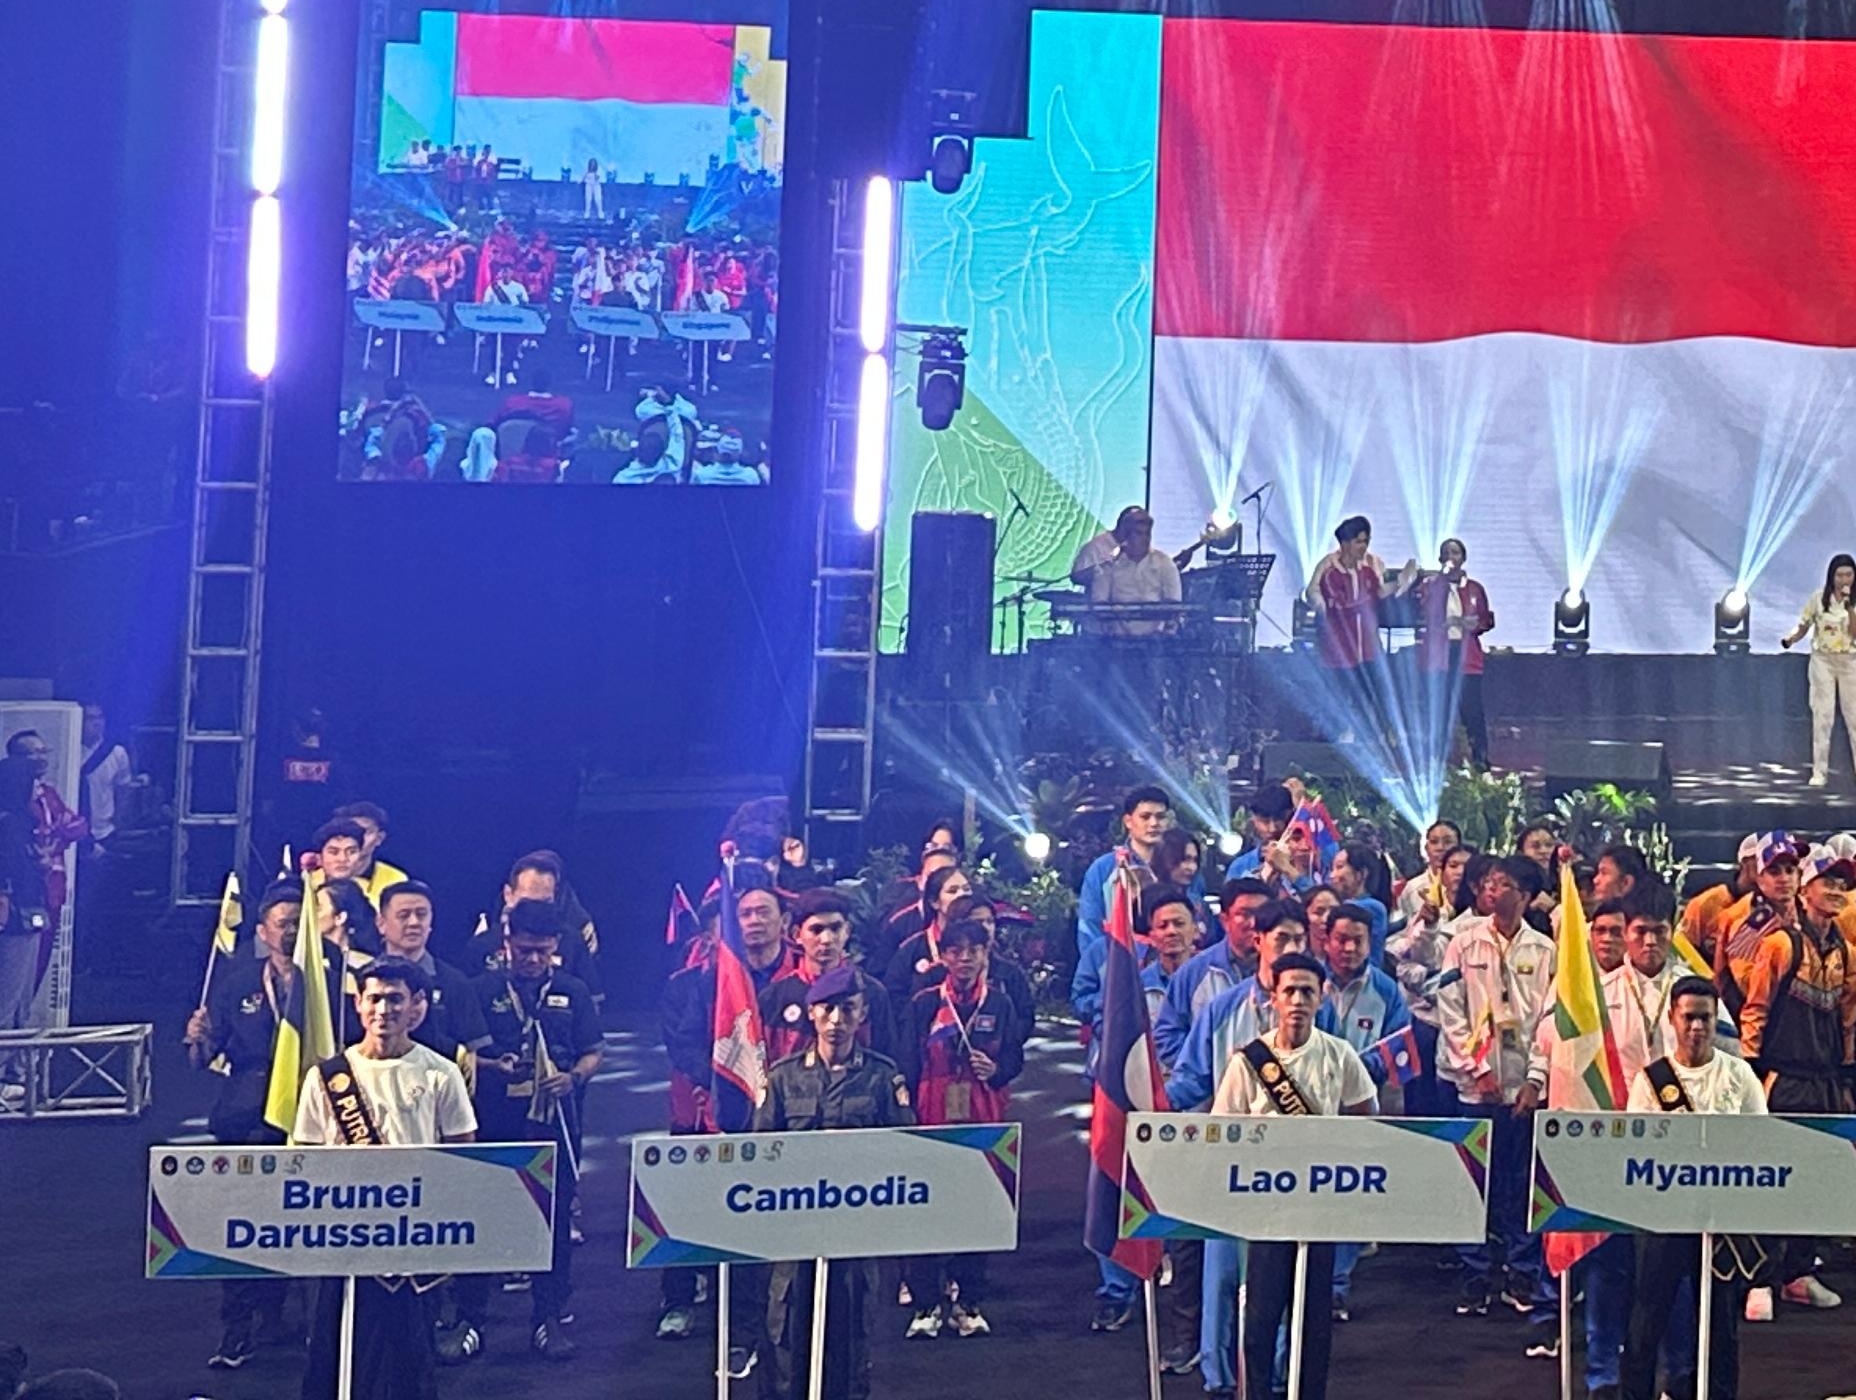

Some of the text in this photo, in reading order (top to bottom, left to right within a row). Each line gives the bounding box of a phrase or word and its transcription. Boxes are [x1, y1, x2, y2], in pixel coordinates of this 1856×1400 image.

[1229, 1164, 1387, 1194] Lao PDR
[1625, 1158, 1793, 1192] Myanmar
[283, 1176, 422, 1210] Brunei
[726, 1175, 929, 1213] Cambodia
[226, 1214, 475, 1249] Darussalam
